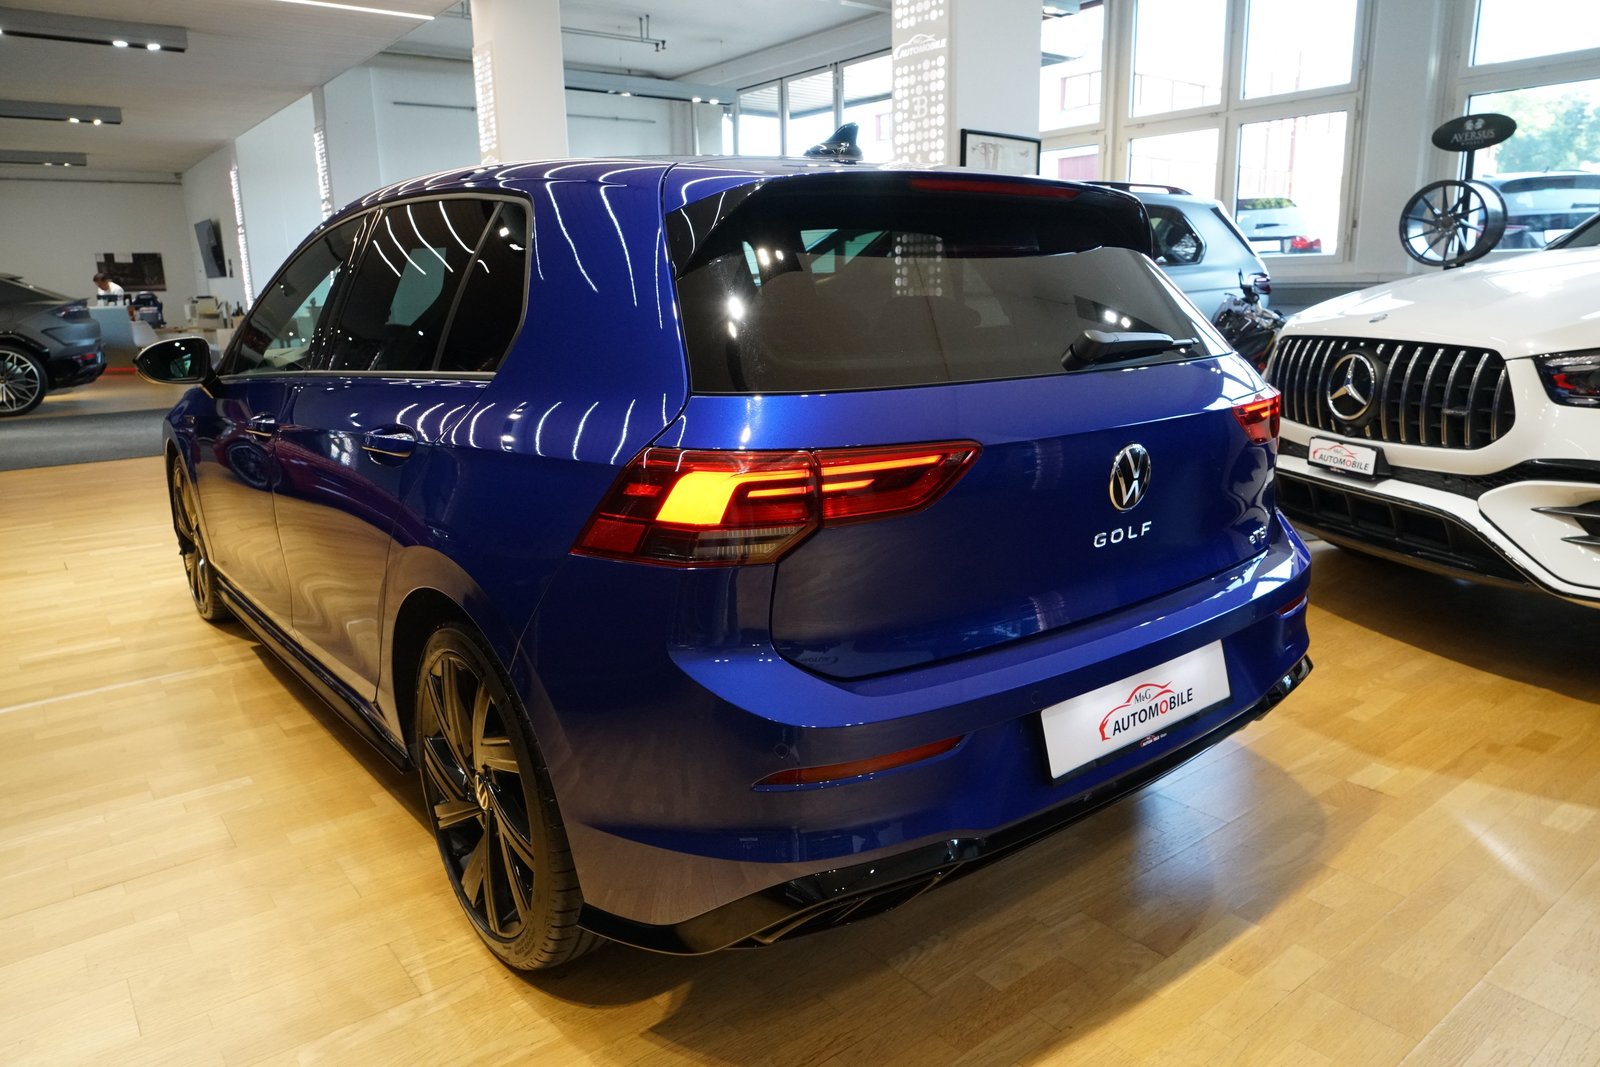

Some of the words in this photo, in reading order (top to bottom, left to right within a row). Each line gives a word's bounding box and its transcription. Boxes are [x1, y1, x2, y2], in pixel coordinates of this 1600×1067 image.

[1451, 129, 1495, 144] AVERSUS
[1318, 453, 1369, 471] AUTOMOBILE
[1093, 521, 1152, 548] GOLF
[1112, 687, 1193, 736] AUTOMOBILE
